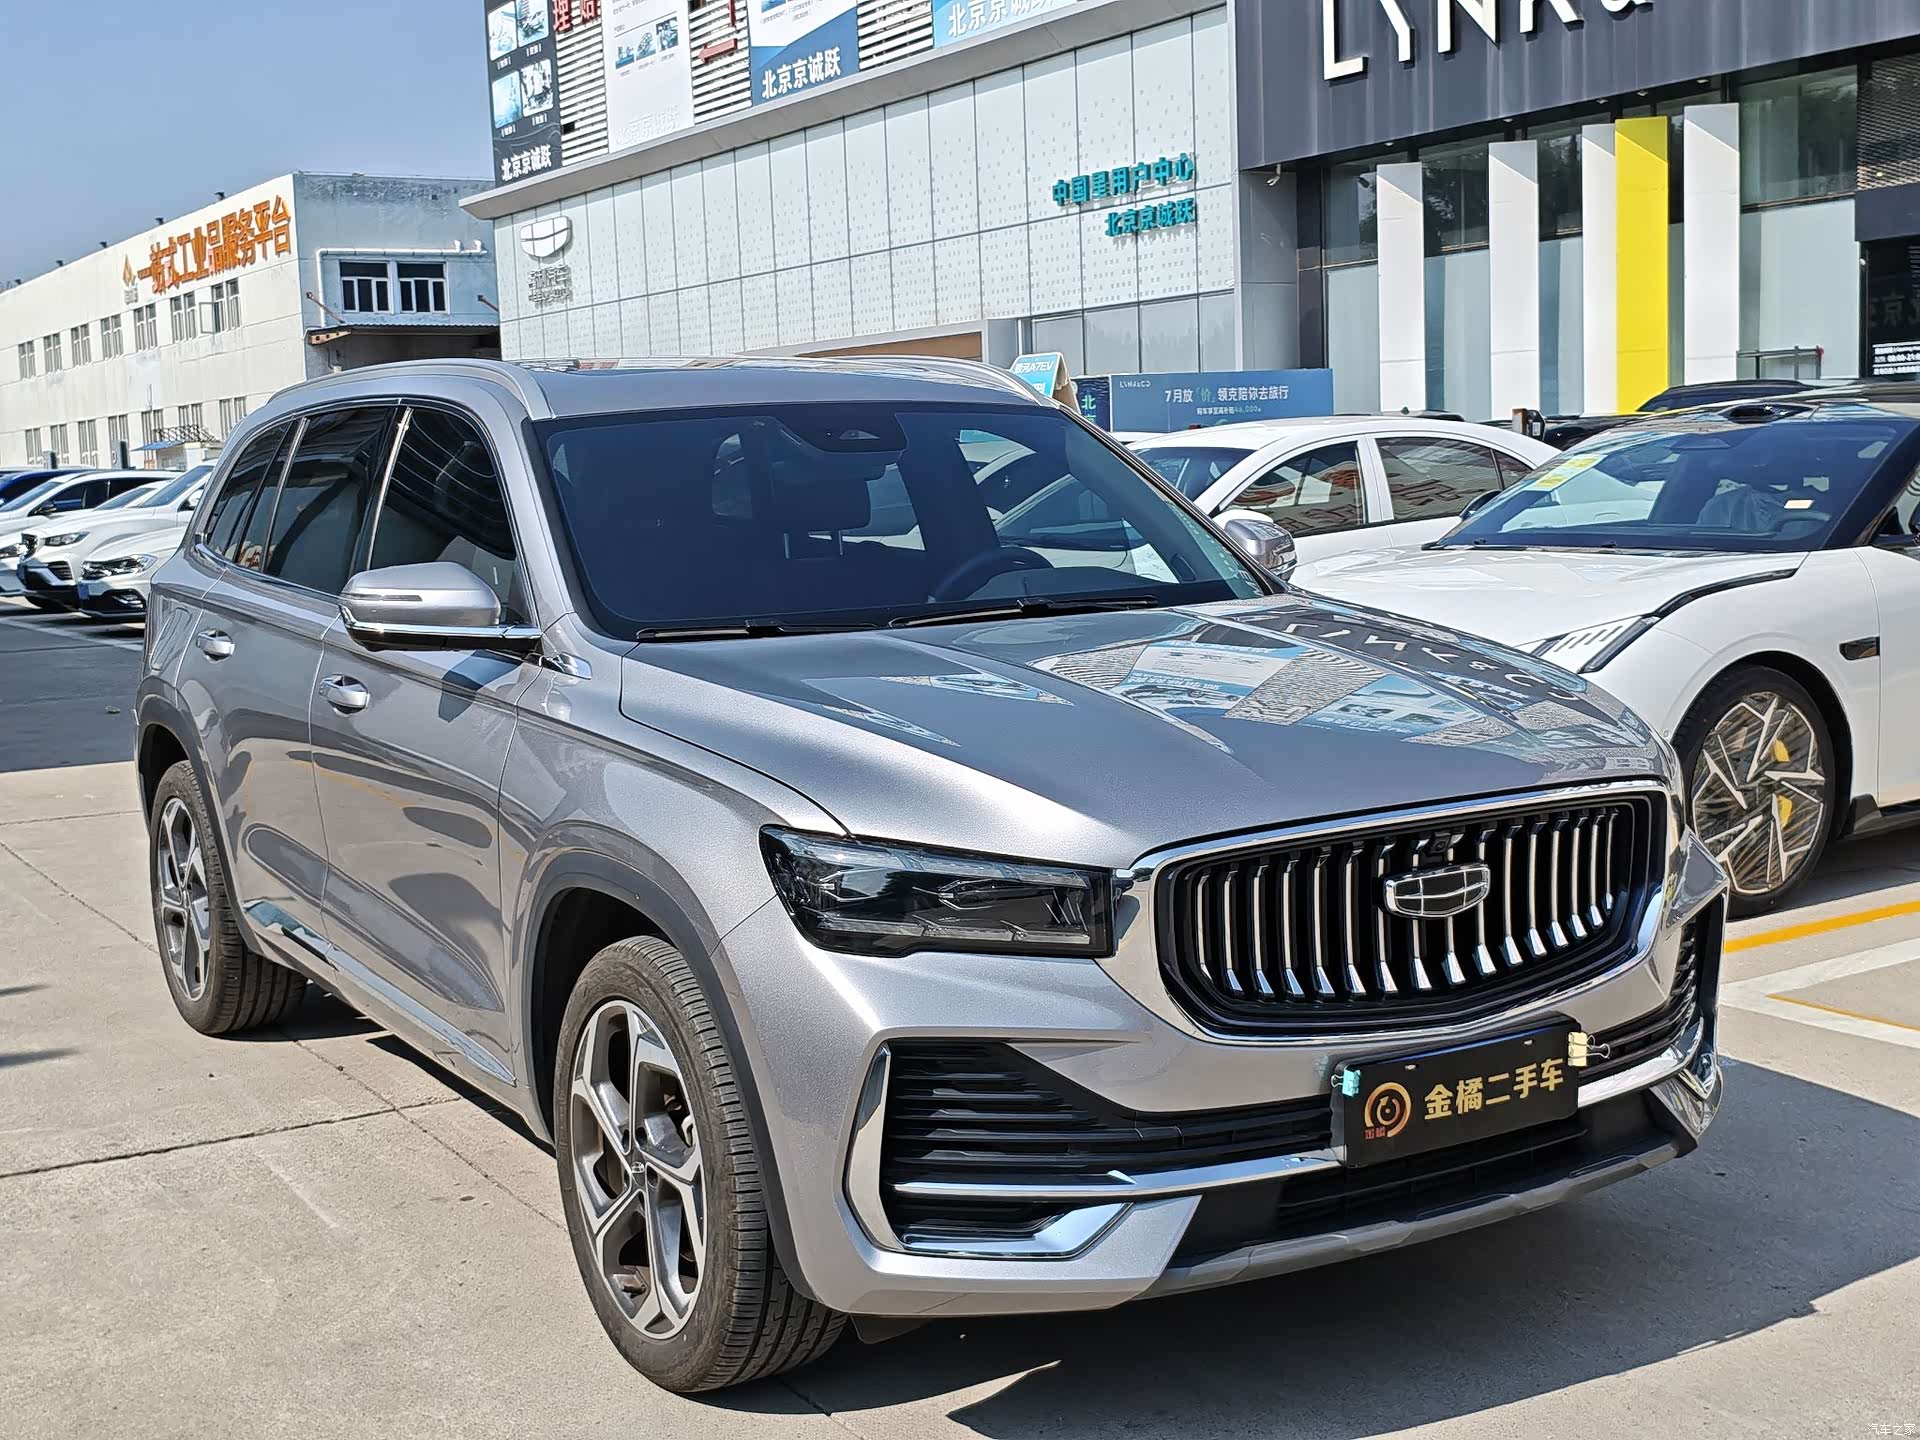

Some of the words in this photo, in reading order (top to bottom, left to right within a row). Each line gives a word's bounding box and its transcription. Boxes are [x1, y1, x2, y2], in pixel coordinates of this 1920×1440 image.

[762, 46, 841, 99] 北京京诚跃
[501, 144, 552, 181] 北京京诚跃
[1052, 153, 1195, 206] 中国星用户中心
[1105, 198, 1196, 237] 北京京诚跃
[137, 195, 291, 295] 一站式工业品服务平台
[1424, 1057, 1564, 1120] 金橘二手车
